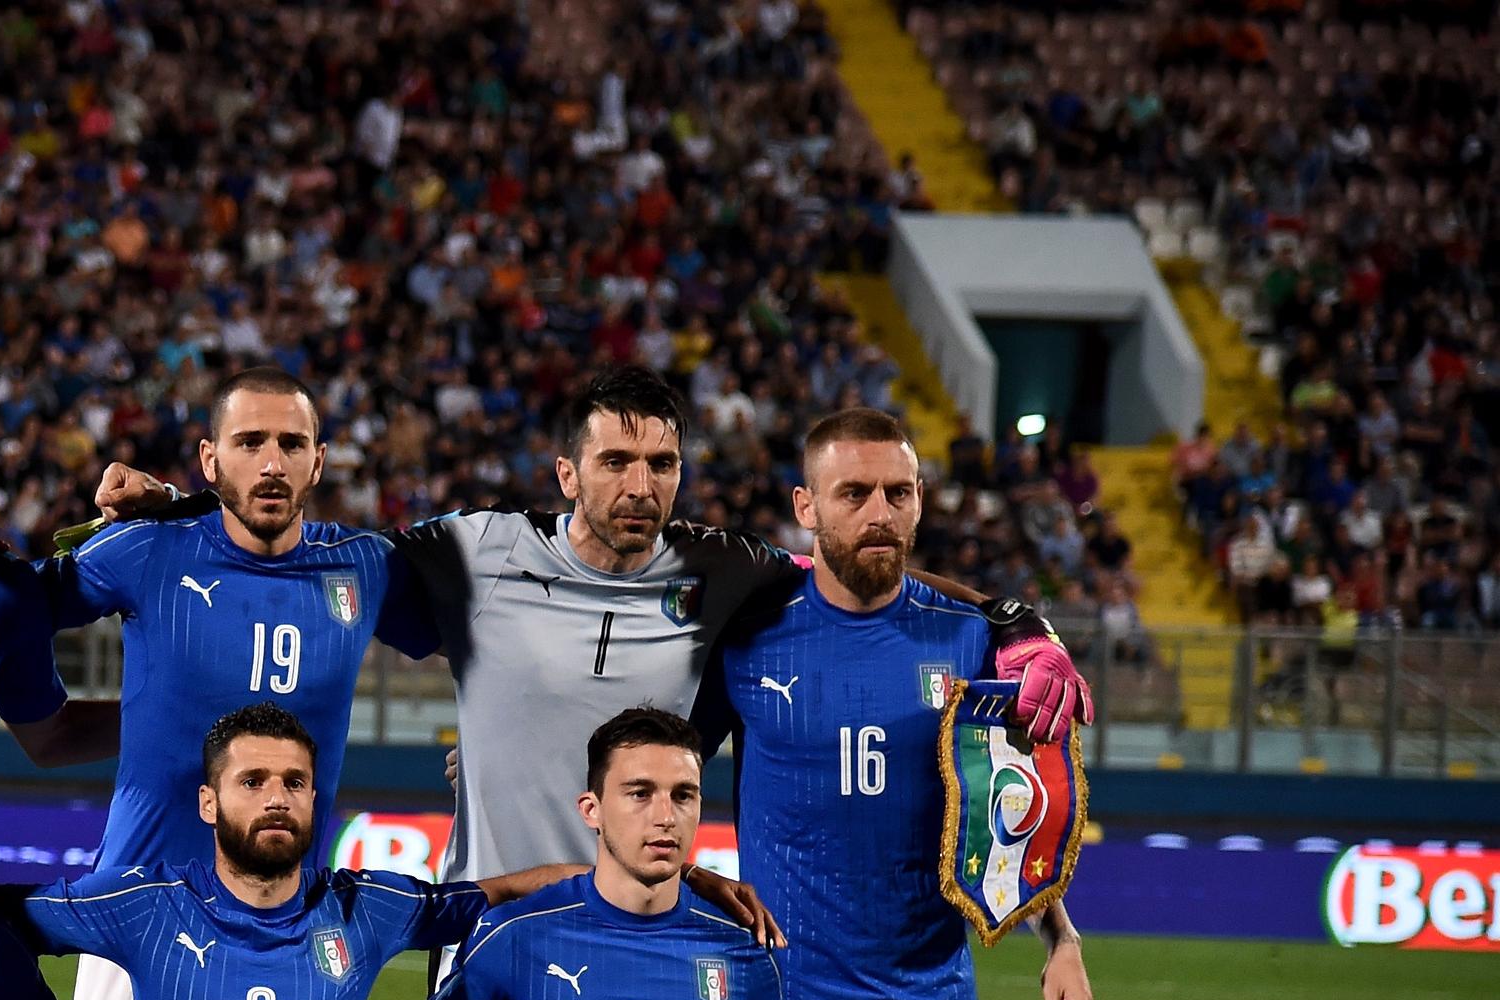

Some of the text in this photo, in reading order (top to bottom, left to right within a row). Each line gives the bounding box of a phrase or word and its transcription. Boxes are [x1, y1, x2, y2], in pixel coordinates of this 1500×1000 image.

[328, 579, 350, 587] ITALIA
[250, 623, 300, 693] 19
[594, 611, 615, 675] 1
[840, 726, 885, 795] 16
[1346, 857, 1500, 943] Be
[316, 933, 338, 942] ITALIA
